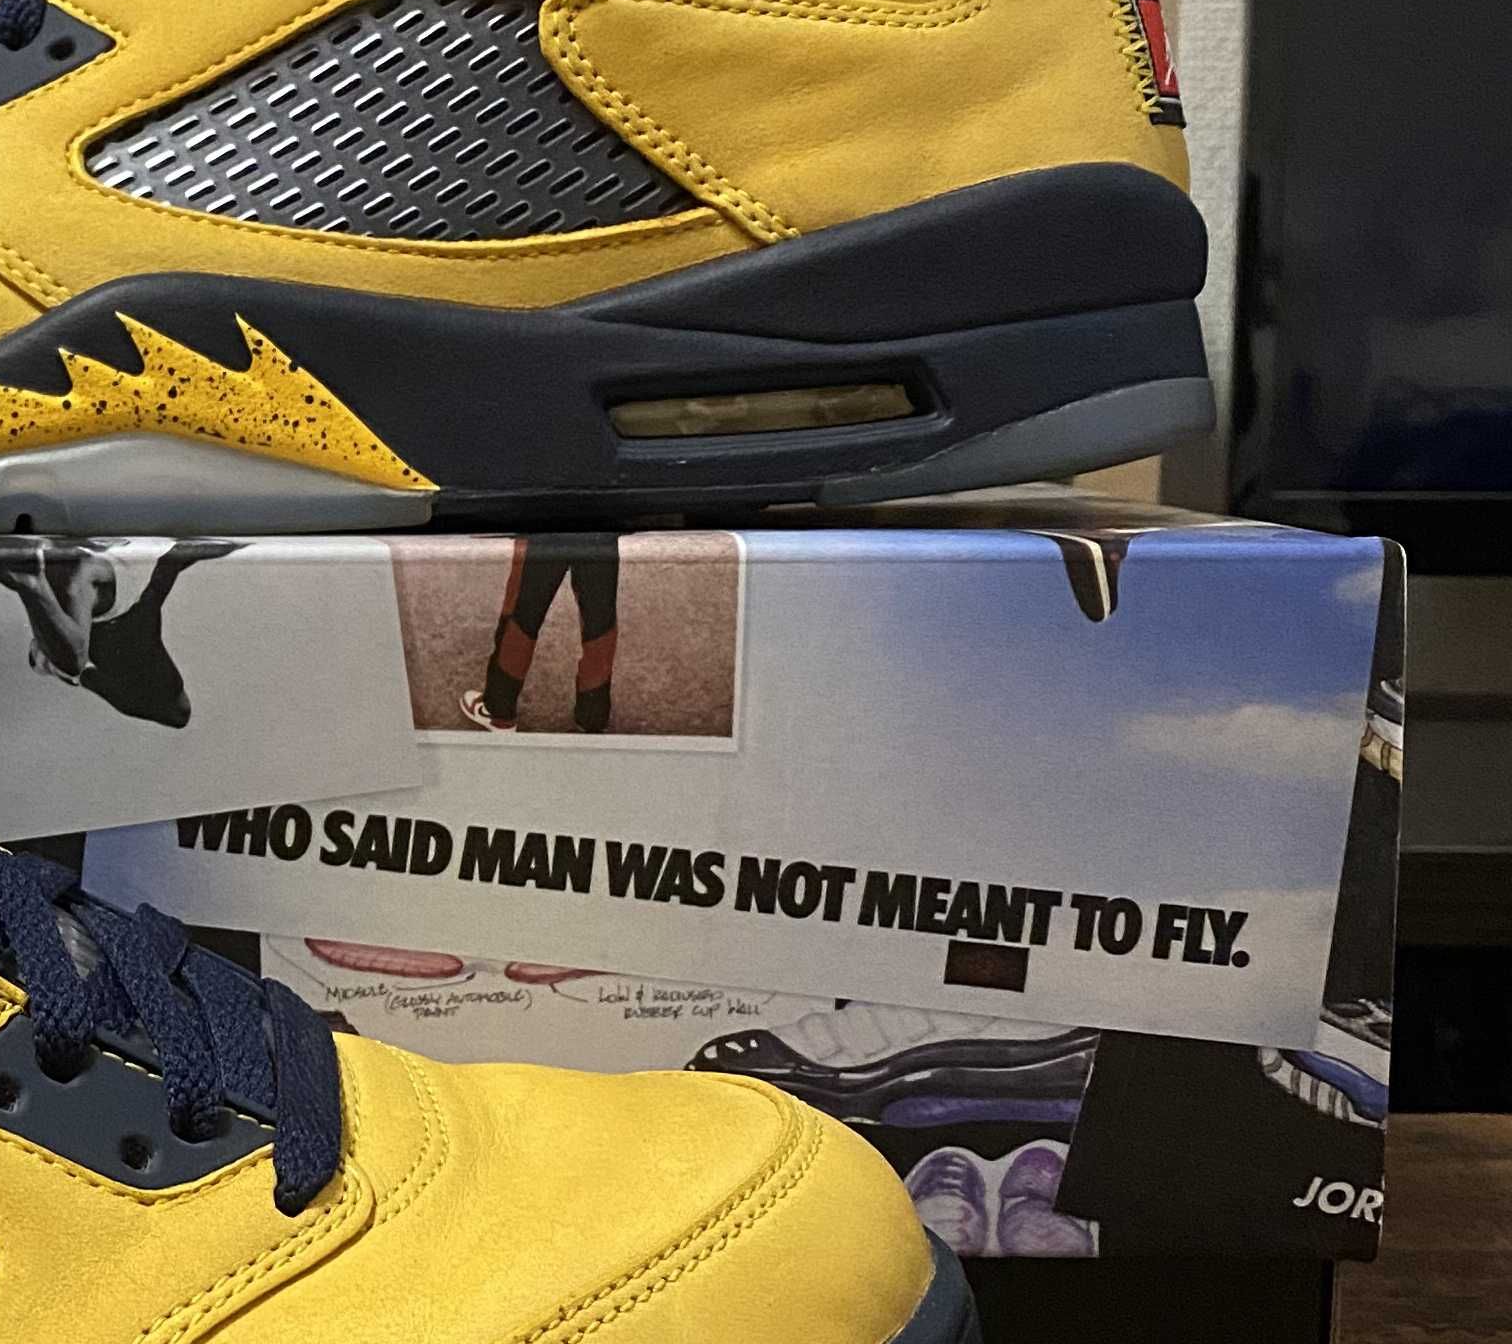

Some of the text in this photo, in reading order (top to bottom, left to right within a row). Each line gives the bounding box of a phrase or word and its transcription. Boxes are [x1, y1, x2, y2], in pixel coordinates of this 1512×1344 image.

[176, 804, 1251, 968] WHO SAID MAN WAS NOT MEANT TO FLY.
[1292, 1176, 1384, 1225] JOR
